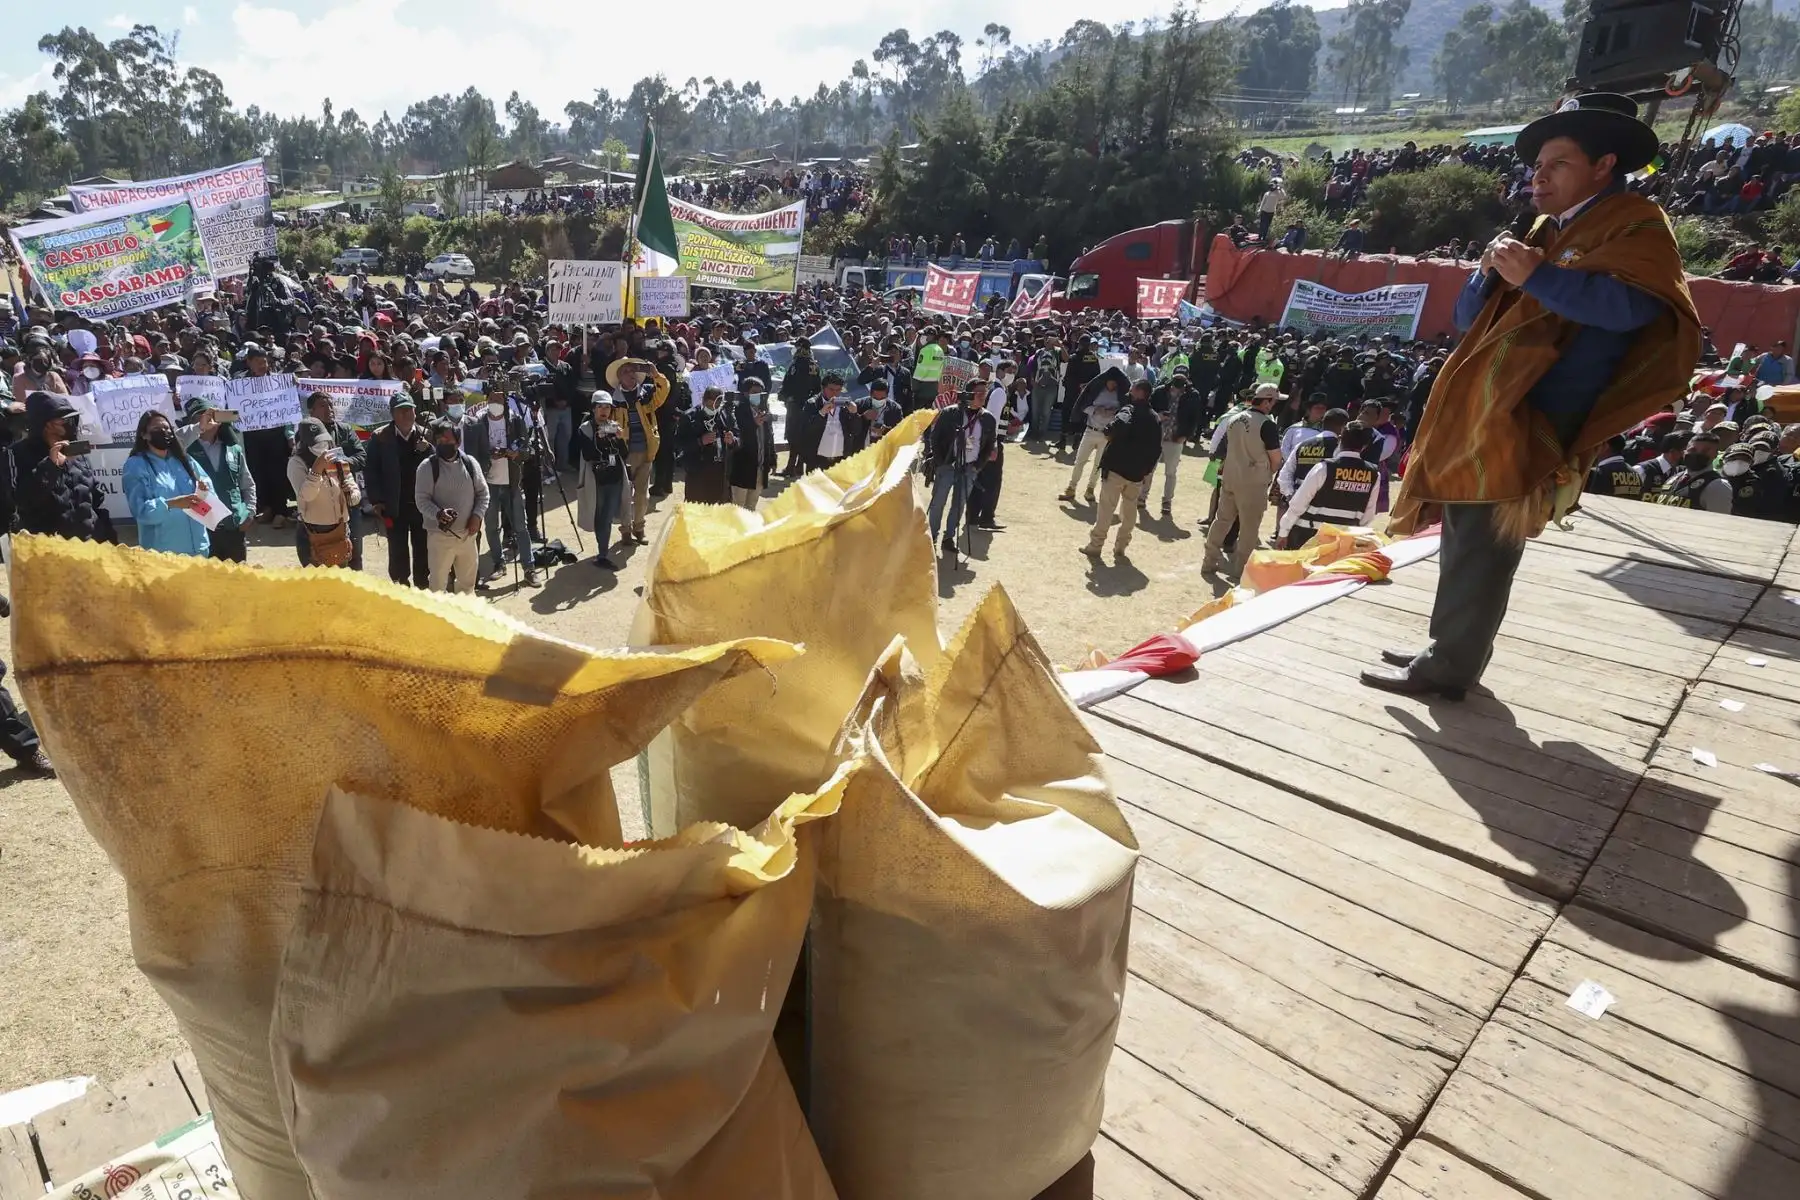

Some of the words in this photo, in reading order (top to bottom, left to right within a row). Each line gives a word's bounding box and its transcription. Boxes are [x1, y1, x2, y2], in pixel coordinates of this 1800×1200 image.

[196, 165, 264, 190] PRESENTE
[194, 195, 210, 208] LA
[211, 181, 270, 206] REPUBLICA
[229, 205, 265, 219] PROYECTO
[688, 233, 708, 246] POR
[45, 235, 139, 268] CASTILLO
[683, 245, 766, 265] DISTRITALIZACION
[686, 261, 697, 271] DE
[699, 260, 756, 278] ANCATIRA
[103, 303, 117, 315] SU
[301, 383, 355, 395] PRESIDENTE
[1299, 446, 1325, 457] POLICIA
[1335, 467, 1372, 482] POLICIA
[1612, 471, 1641, 486] POLICIA
[1642, 492, 1692, 508] POLICIA
